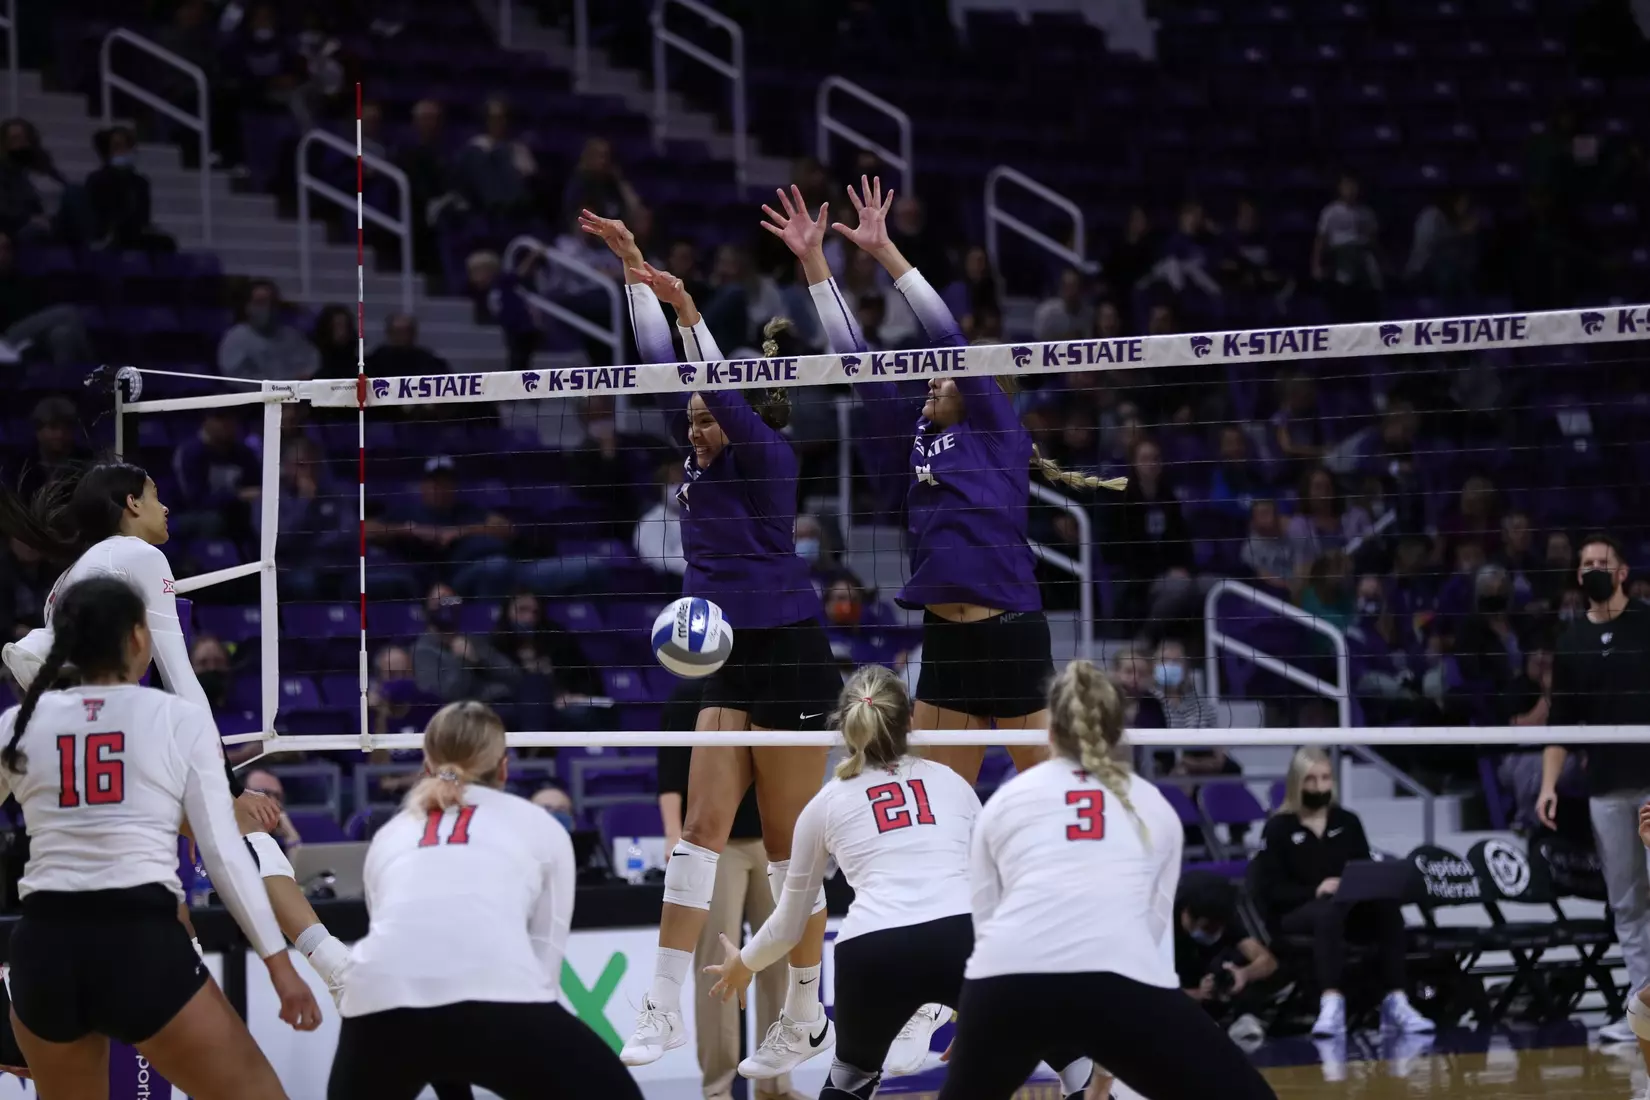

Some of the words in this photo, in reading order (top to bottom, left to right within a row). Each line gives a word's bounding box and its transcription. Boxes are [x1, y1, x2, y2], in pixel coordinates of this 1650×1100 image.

[1223, 328, 1329, 357] K-STATE
[1414, 316, 1526, 346] K-STATE
[871, 349, 966, 375] K-STATE
[1042, 339, 1143, 366] K-STATE
[549, 366, 636, 391] K-STATE
[706, 358, 798, 384] K-STATE
[398, 374, 483, 399] K-STATE
[57, 731, 124, 807] 16
[866, 779, 936, 834] 21
[1065, 790, 1104, 841] 3
[1415, 854, 1475, 878] Capitol
[1423, 875, 1482, 899] Federal
